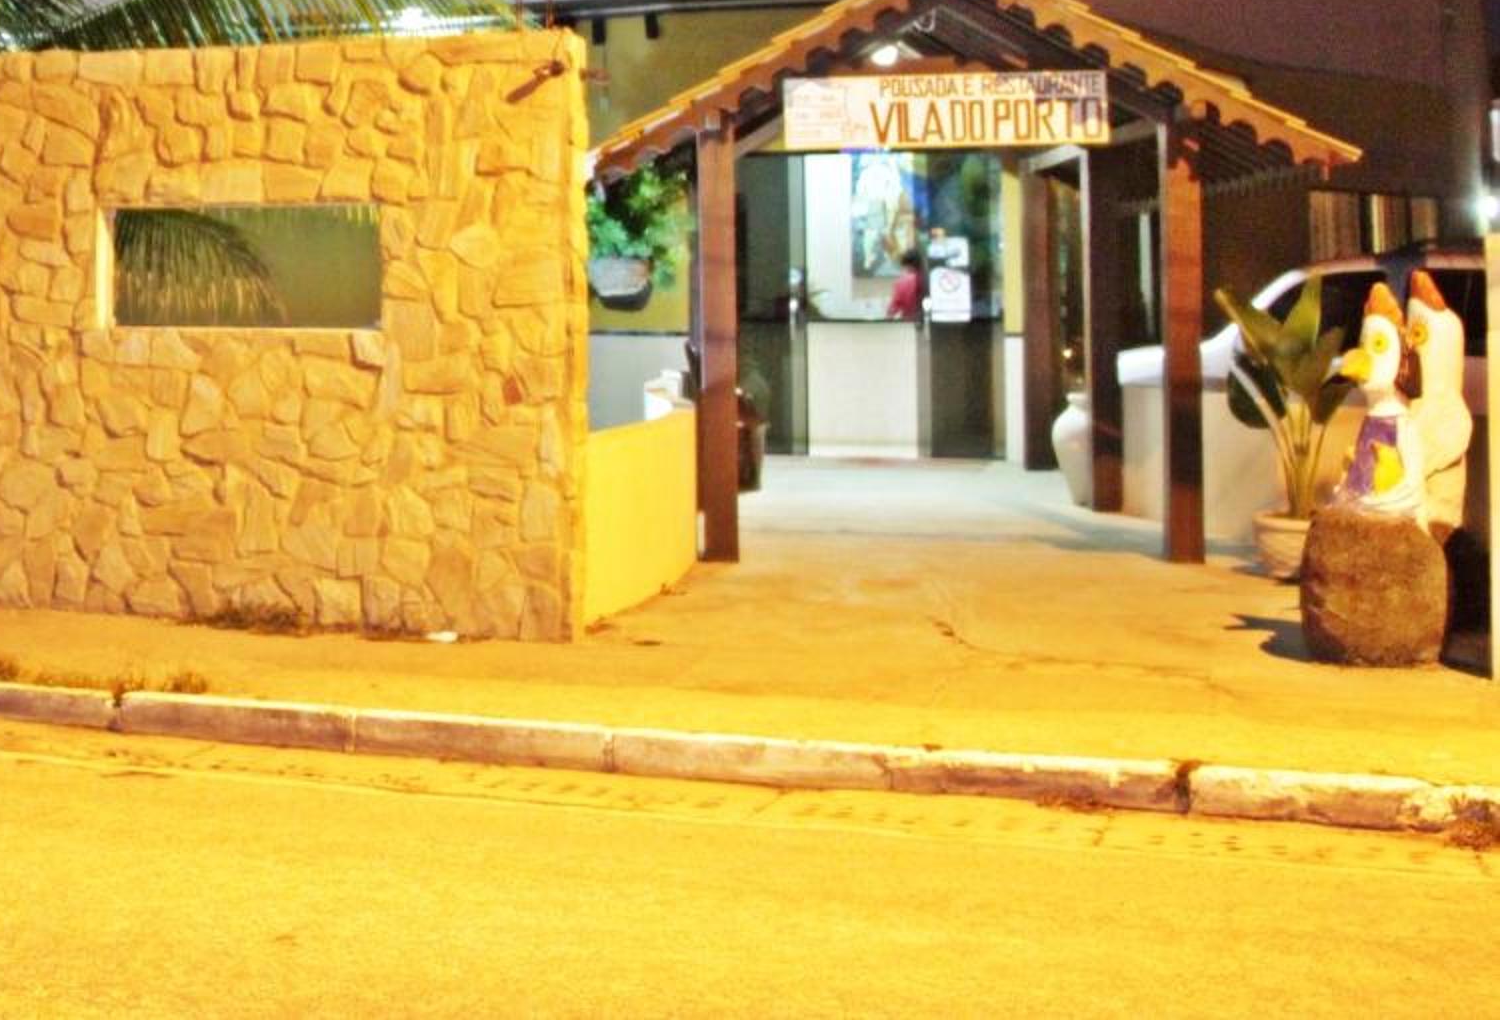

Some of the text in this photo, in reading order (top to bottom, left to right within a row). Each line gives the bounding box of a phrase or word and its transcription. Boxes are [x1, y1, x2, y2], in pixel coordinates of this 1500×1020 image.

[878, 72, 1100, 98] POUSADA E RESTAURANTE
[870, 97, 1102, 144] VILA DO PORTO
